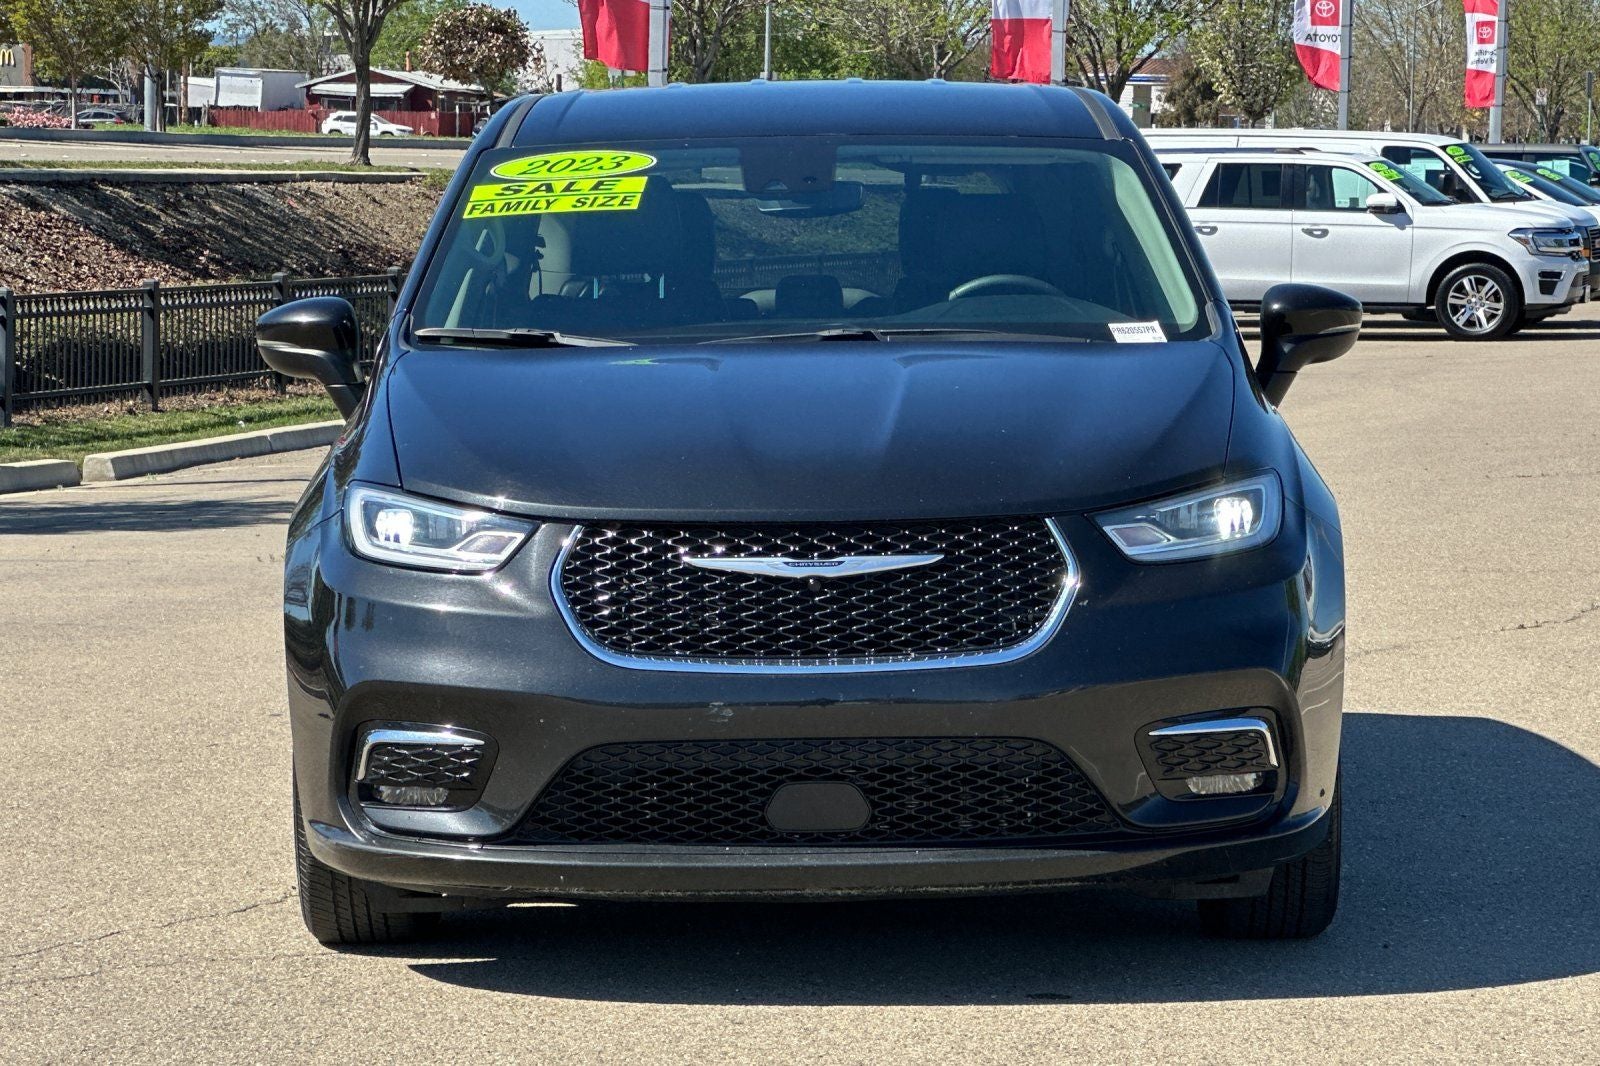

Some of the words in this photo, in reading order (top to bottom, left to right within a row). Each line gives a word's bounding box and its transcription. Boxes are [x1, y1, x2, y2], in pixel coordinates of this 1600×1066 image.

[517, 155, 631, 175] 2023
[495, 179, 621, 196] SALE
[467, 199, 558, 215] FAMILY
[571, 194, 636, 209] SIZE
